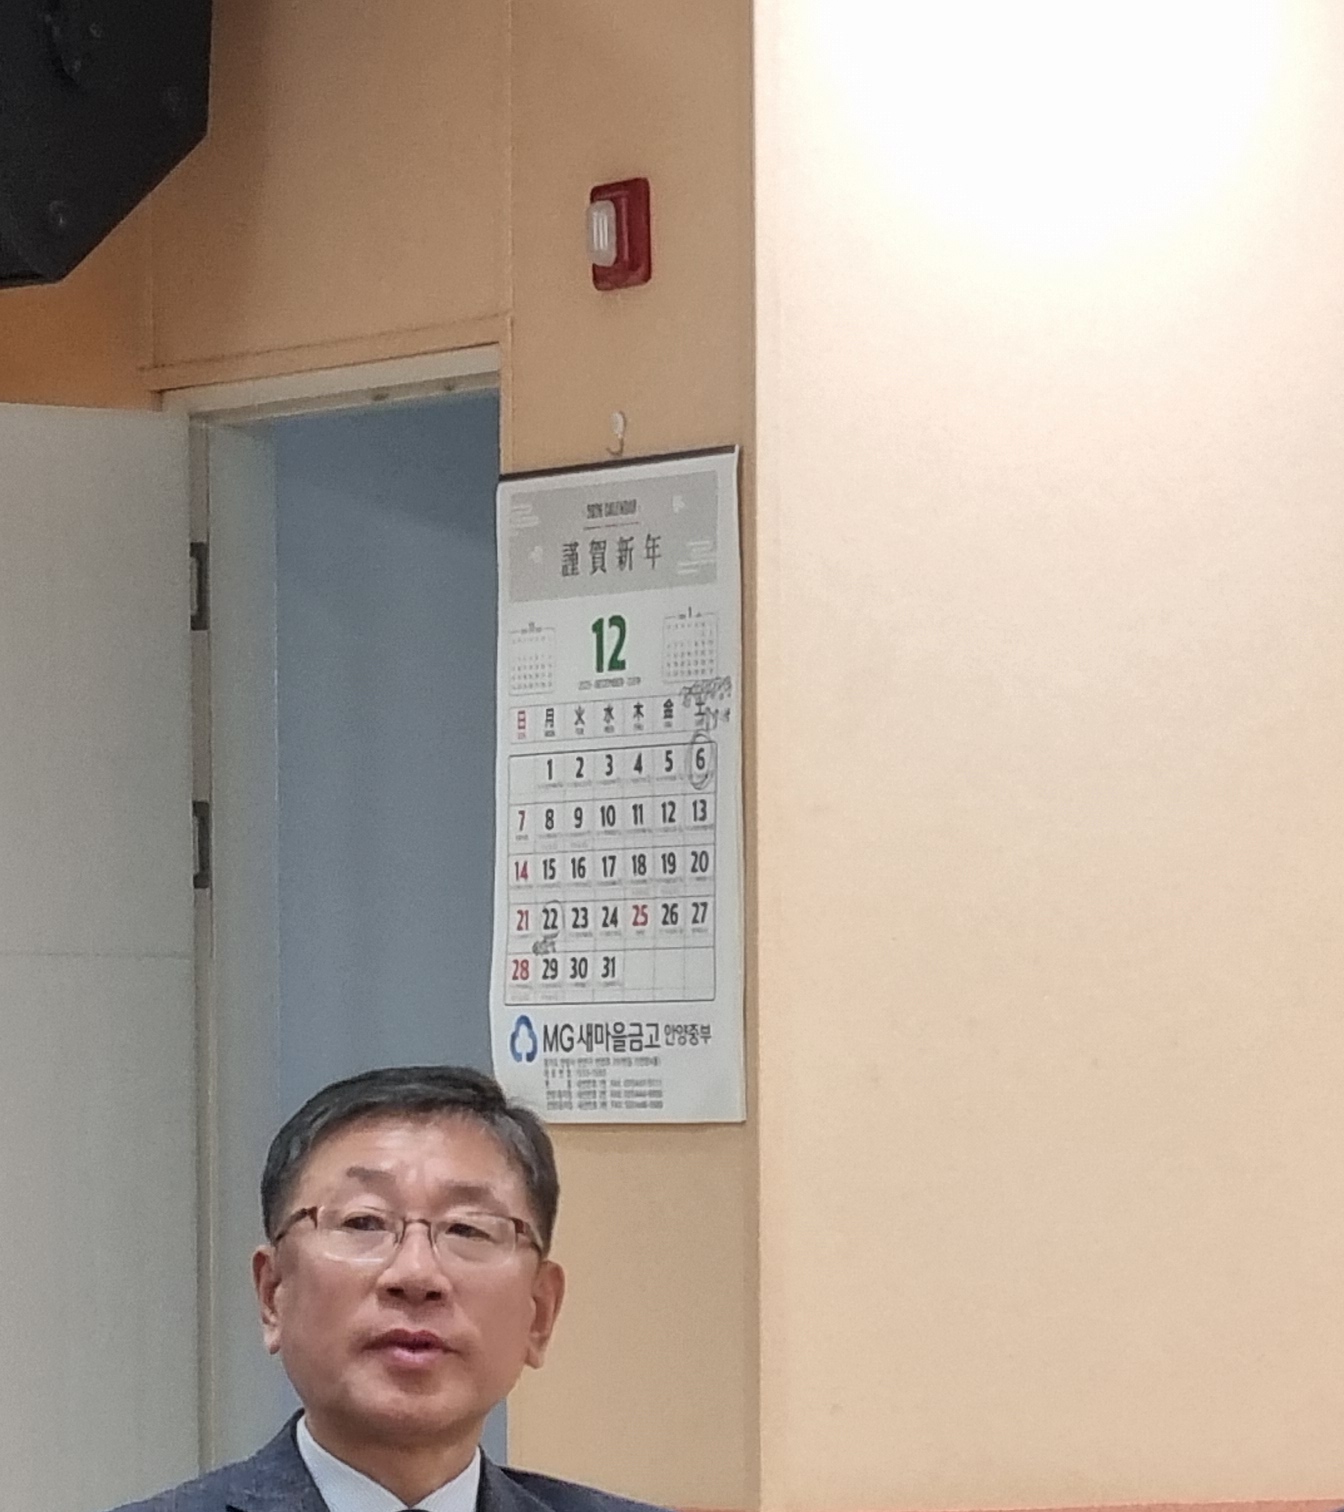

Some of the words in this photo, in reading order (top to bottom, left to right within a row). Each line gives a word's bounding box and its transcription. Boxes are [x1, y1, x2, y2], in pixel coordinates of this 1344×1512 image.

[561, 533, 662, 577] 謹賀新年
[591, 614, 627, 673] 12
[574, 705, 586, 726] 火
[633, 702, 645, 719] 木
[662, 698, 674, 720] 金
[546, 758, 553, 781] 1
[575, 756, 585, 779] 2
[605, 753, 614, 777] 3
[633, 752, 643, 774] 4
[664, 749, 674, 773] 5
[695, 747, 706, 771] 6
[518, 809, 526, 832] 7
[544, 808, 555, 831] 8
[573, 806, 584, 829] 9
[600, 804, 616, 828] 10
[631, 803, 644, 826] 11
[660, 800, 676, 824] 12
[692, 798, 707, 822] 13
[514, 860, 529, 881] 14
[542, 857, 557, 880] 15
[570, 856, 587, 879] 16
[601, 854, 617, 878] 17
[631, 853, 647, 876] 18
[660, 851, 677, 875] 19
[690, 850, 710, 874] 20
[516, 909, 530, 932] 21
[541, 907, 559, 931] 22
[571, 906, 589, 929] 23
[601, 905, 619, 928] 24
[631, 904, 649, 927] 25
[661, 902, 679, 926] 26
[691, 901, 709, 925] 27
[511, 958, 530, 981] 28
[541, 957, 559, 981] 29
[569, 957, 589, 980] 30
[600, 956, 616, 979] 31
[664, 1024, 712, 1046] 안양중부
